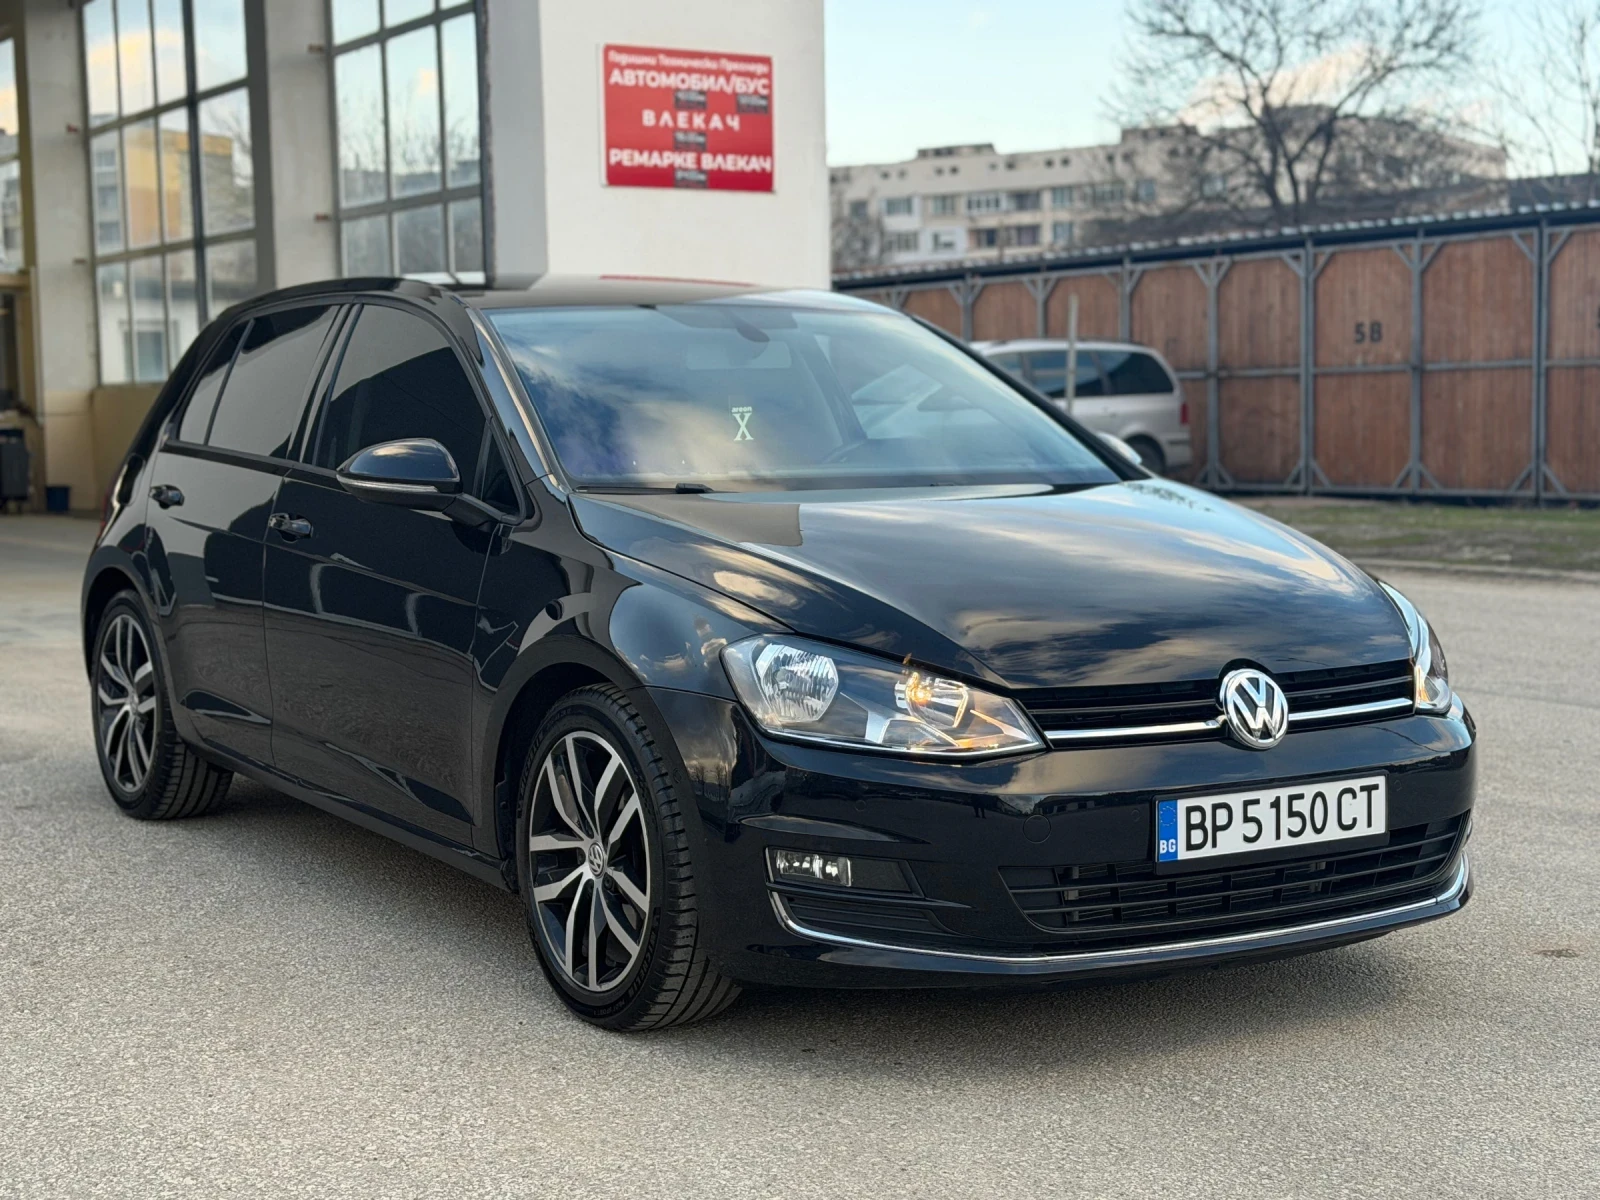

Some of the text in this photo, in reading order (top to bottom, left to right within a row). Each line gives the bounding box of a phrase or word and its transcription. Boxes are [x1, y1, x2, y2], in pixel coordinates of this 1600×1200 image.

[609, 68, 769, 95] АВТОМОБИЛ/БУС
[641, 109, 740, 131] ВЛЕКАЧ
[609, 148, 772, 173] РЕМАРКЕ ВЛЕКАЧ
[732, 412, 754, 441] X
[1242, 791, 1328, 844] 5150
[1159, 839, 1177, 854] BG
